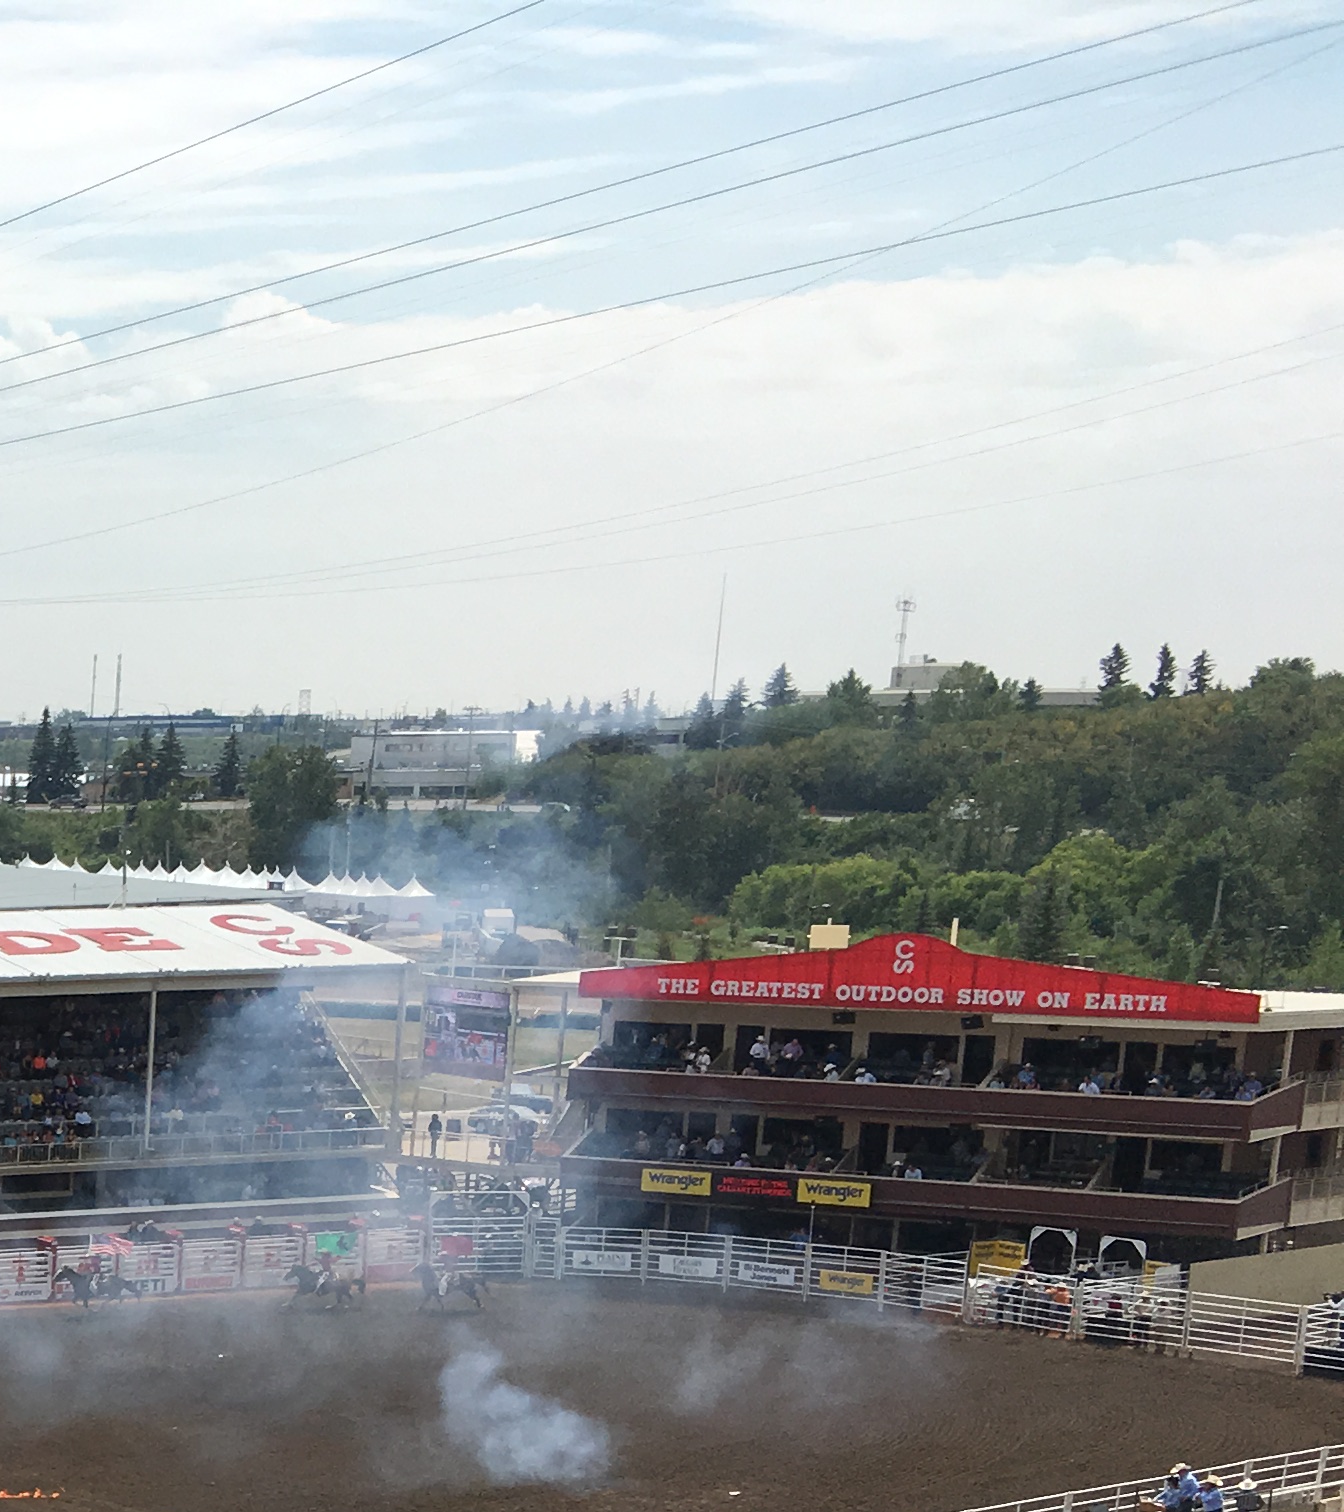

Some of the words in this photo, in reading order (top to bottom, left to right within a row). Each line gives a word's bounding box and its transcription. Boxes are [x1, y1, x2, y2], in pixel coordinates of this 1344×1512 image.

[658, 978, 699, 996] THE
[711, 979, 824, 999] GREATEST
[835, 984, 944, 1004] OUTDOOR
[957, 988, 1026, 1007] SHOW
[1037, 991, 1068, 1009] ON
[1084, 992, 1167, 1012] EARTH
[648, 1171, 706, 1190] Wrangler
[805, 1182, 865, 1202] Wrangler
[829, 1274, 866, 1289] Wrangler
